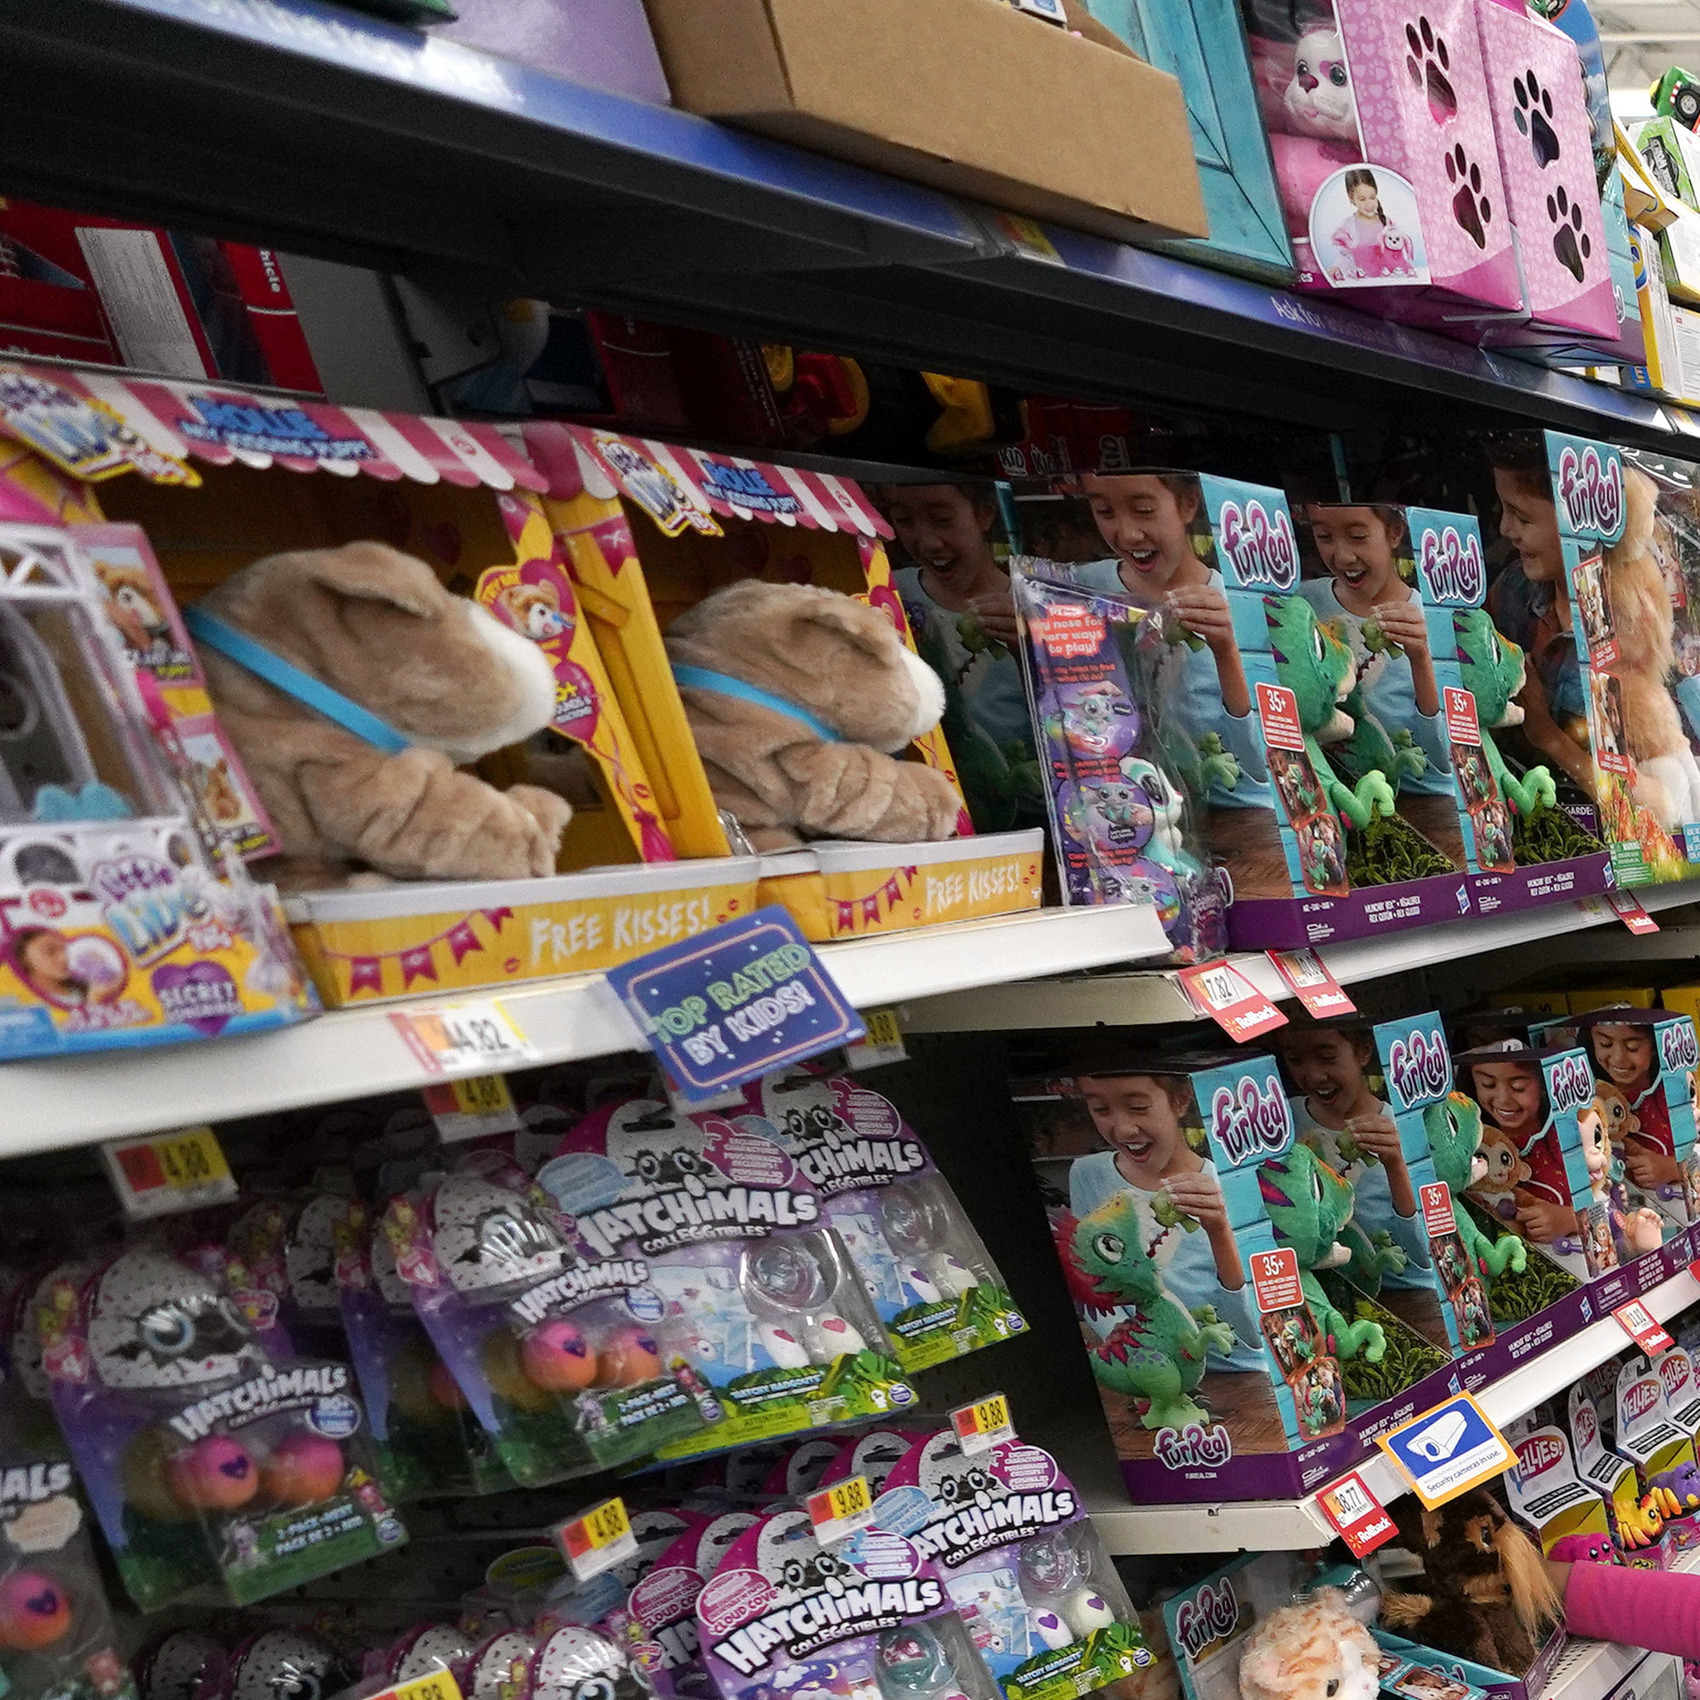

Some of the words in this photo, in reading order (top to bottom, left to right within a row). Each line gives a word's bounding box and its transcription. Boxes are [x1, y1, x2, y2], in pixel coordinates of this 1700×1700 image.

[1557, 446, 1623, 535] furReal
[1221, 500, 1298, 591] furReal
[1415, 522, 1484, 603] furReal
[1266, 691, 1288, 712] 35+
[1450, 693, 1470, 712] 35+
[925, 873, 965, 908] FREE
[968, 861, 1021, 895] KISSES!
[529, 915, 606, 965] FREE
[610, 898, 712, 948] KISSES!
[654, 993, 710, 1043] TOP
[713, 944, 811, 1012] RATED
[1233, 1002, 1280, 1033] Rollback
[1305, 987, 1349, 1012] Rollback
[686, 1028, 728, 1066] BY
[731, 985, 818, 1045] KIDS!
[1662, 1020, 1697, 1071] furReal
[1389, 1027, 1450, 1108] furReal
[1550, 1060, 1595, 1113] furReal
[1214, 1075, 1291, 1164] furReal
[1259, 1255, 1287, 1276] 35+
[1153, 1425, 1230, 1468] furReal
[833, 1482, 865, 1519] 9.88
[1426, 1473, 1452, 1493] Security
[1451, 1459, 1480, 1481] cameras
[1347, 1517, 1392, 1548] Rollback
[715, 1572, 942, 1676] HATCHiMALS
[1175, 1582, 1240, 1658] furReal
